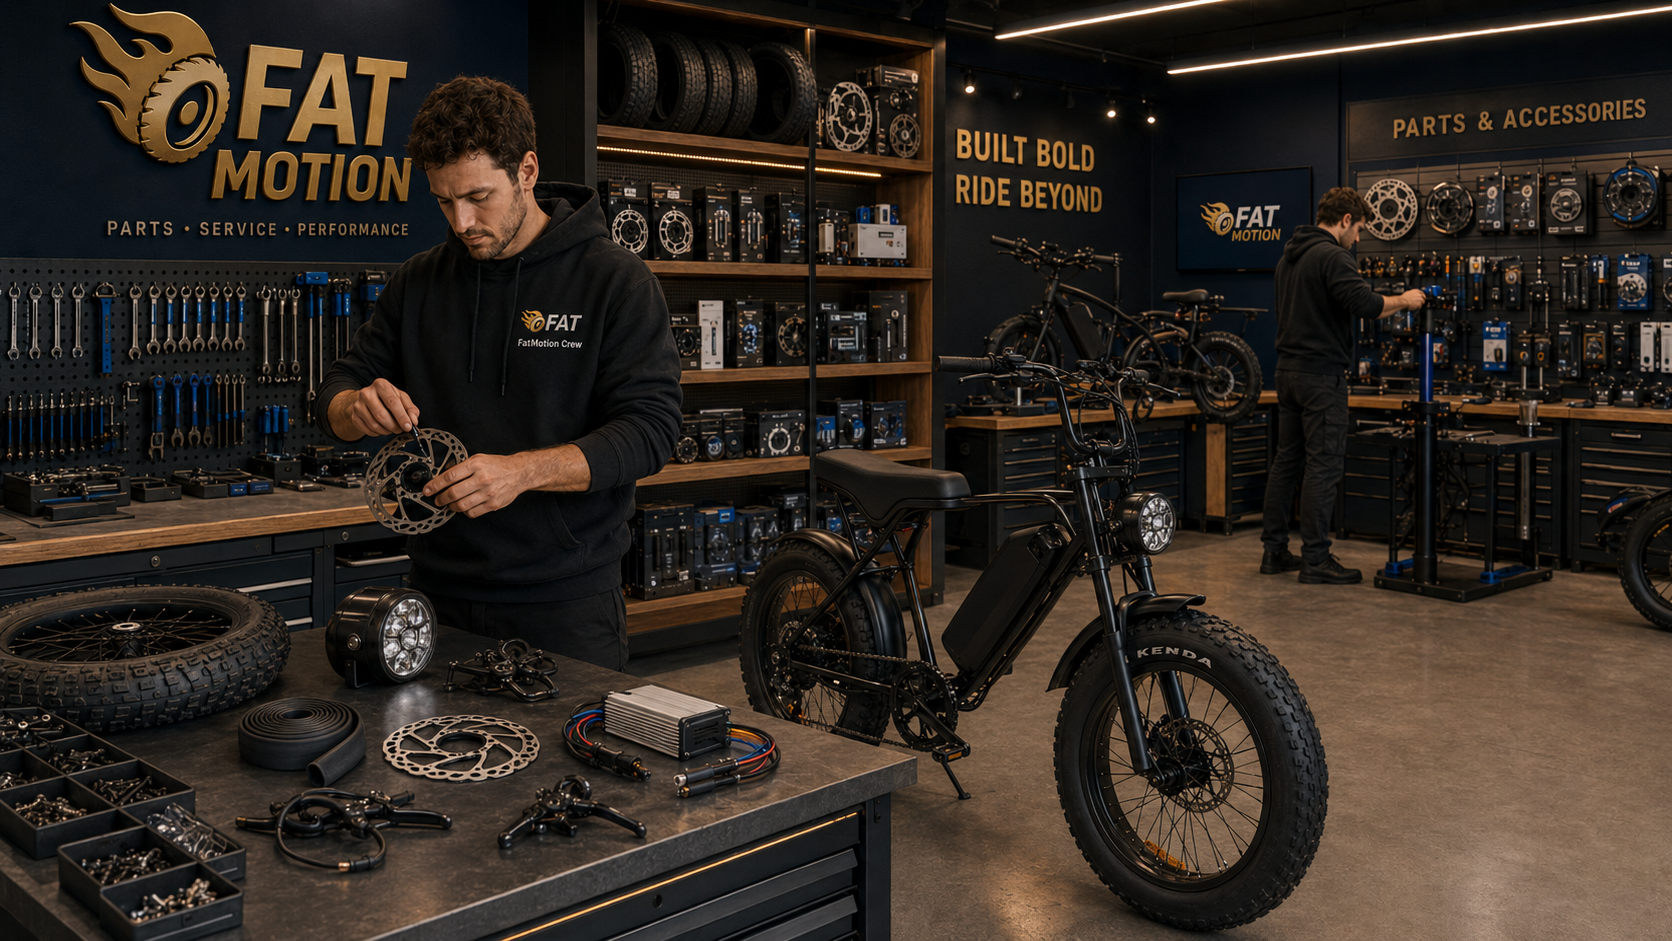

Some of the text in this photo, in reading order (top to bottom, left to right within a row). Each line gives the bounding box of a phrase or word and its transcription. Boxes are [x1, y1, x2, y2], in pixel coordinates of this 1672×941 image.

[238, 44, 408, 147] FAT
[1393, 98, 1647, 139] PARTS & ACCESSORIES
[956, 128, 1095, 172] BUILT BOLD
[211, 149, 412, 202] MOTION
[955, 174, 1103, 213] RIDE BEYOND
[1235, 205, 1280, 228] FAT
[107, 221, 409, 236] PARTS SERVICE PERFORMANCE
[1232, 229, 1281, 242] MOTION
[545, 314, 582, 331] FAT
[517, 338, 583, 348] FatMotion Crew
[1136, 646, 1212, 669] KENDA
